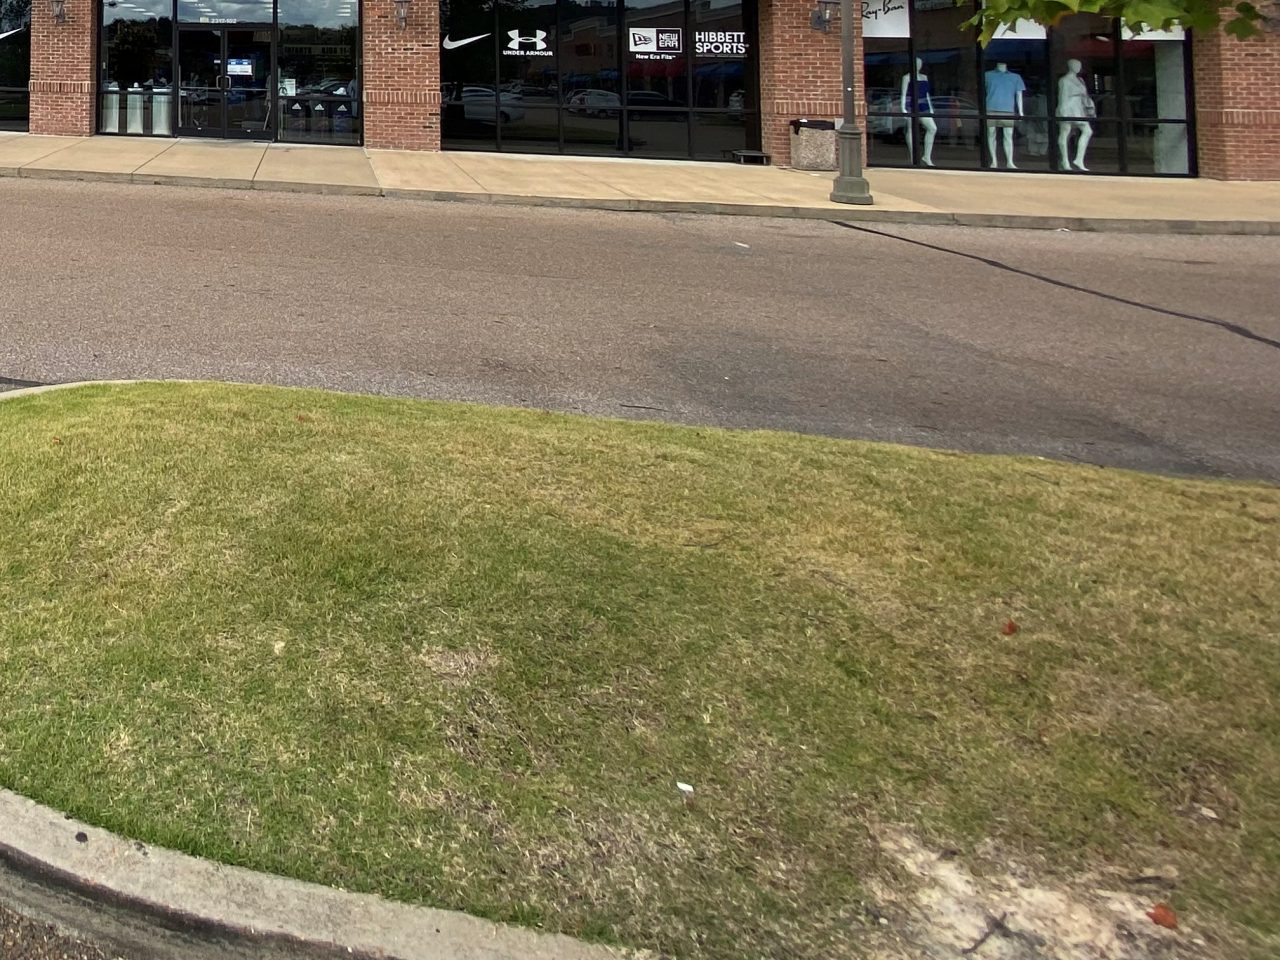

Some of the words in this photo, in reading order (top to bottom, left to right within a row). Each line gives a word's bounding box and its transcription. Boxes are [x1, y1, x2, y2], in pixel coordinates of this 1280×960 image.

[658, 33, 678, 41] NEW
[695, 31, 745, 43] HIBBETT
[658, 40, 678, 49] ERA
[695, 42, 746, 54] SPORTS
